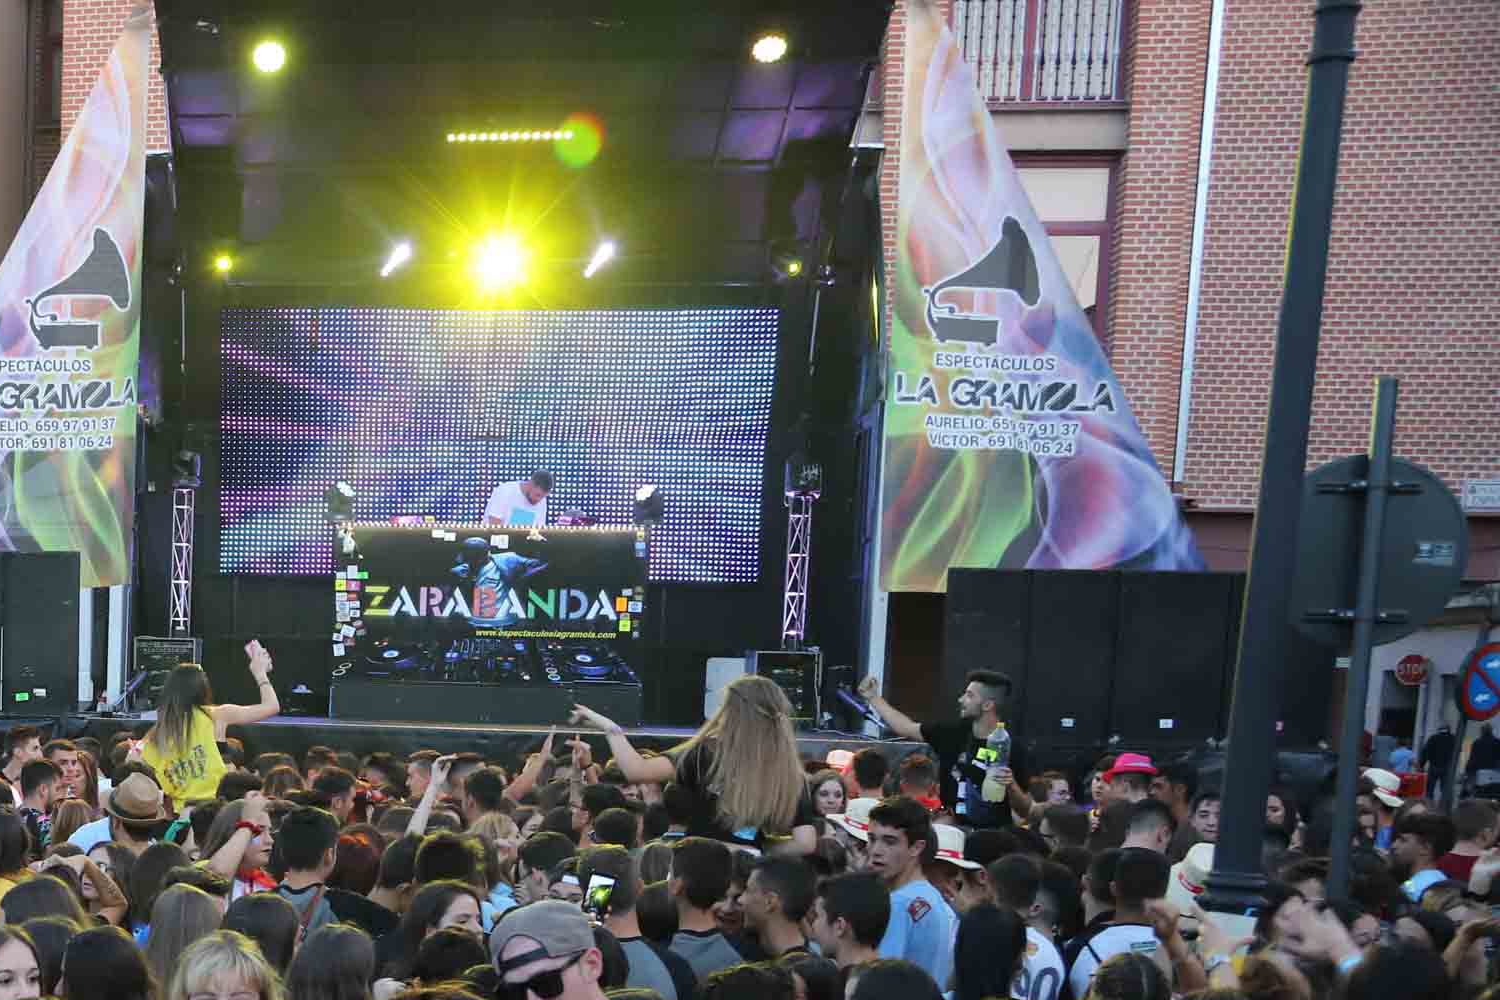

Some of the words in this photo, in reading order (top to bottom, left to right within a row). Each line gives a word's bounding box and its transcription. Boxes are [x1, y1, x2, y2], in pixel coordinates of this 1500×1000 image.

[896, 374, 938, 405] LA
[951, 377, 1115, 411] GRAMOLA
[35, 420, 59, 432] 659
[63, 420, 79, 432] 97
[82, 419, 97, 431] 91
[101, 418, 116, 431] 37
[1038, 423, 1056, 436] 91
[1061, 423, 1079, 437] 37
[32, 437, 54, 449] 691
[59, 436, 74, 448] 81
[78, 436, 94, 448] 06
[97, 435, 112, 447] 24
[988, 434, 1013, 447] 691
[1030, 440, 1051, 454] 06
[1055, 442, 1073, 454] 24
[363, 585, 618, 620] ZARABANDA
